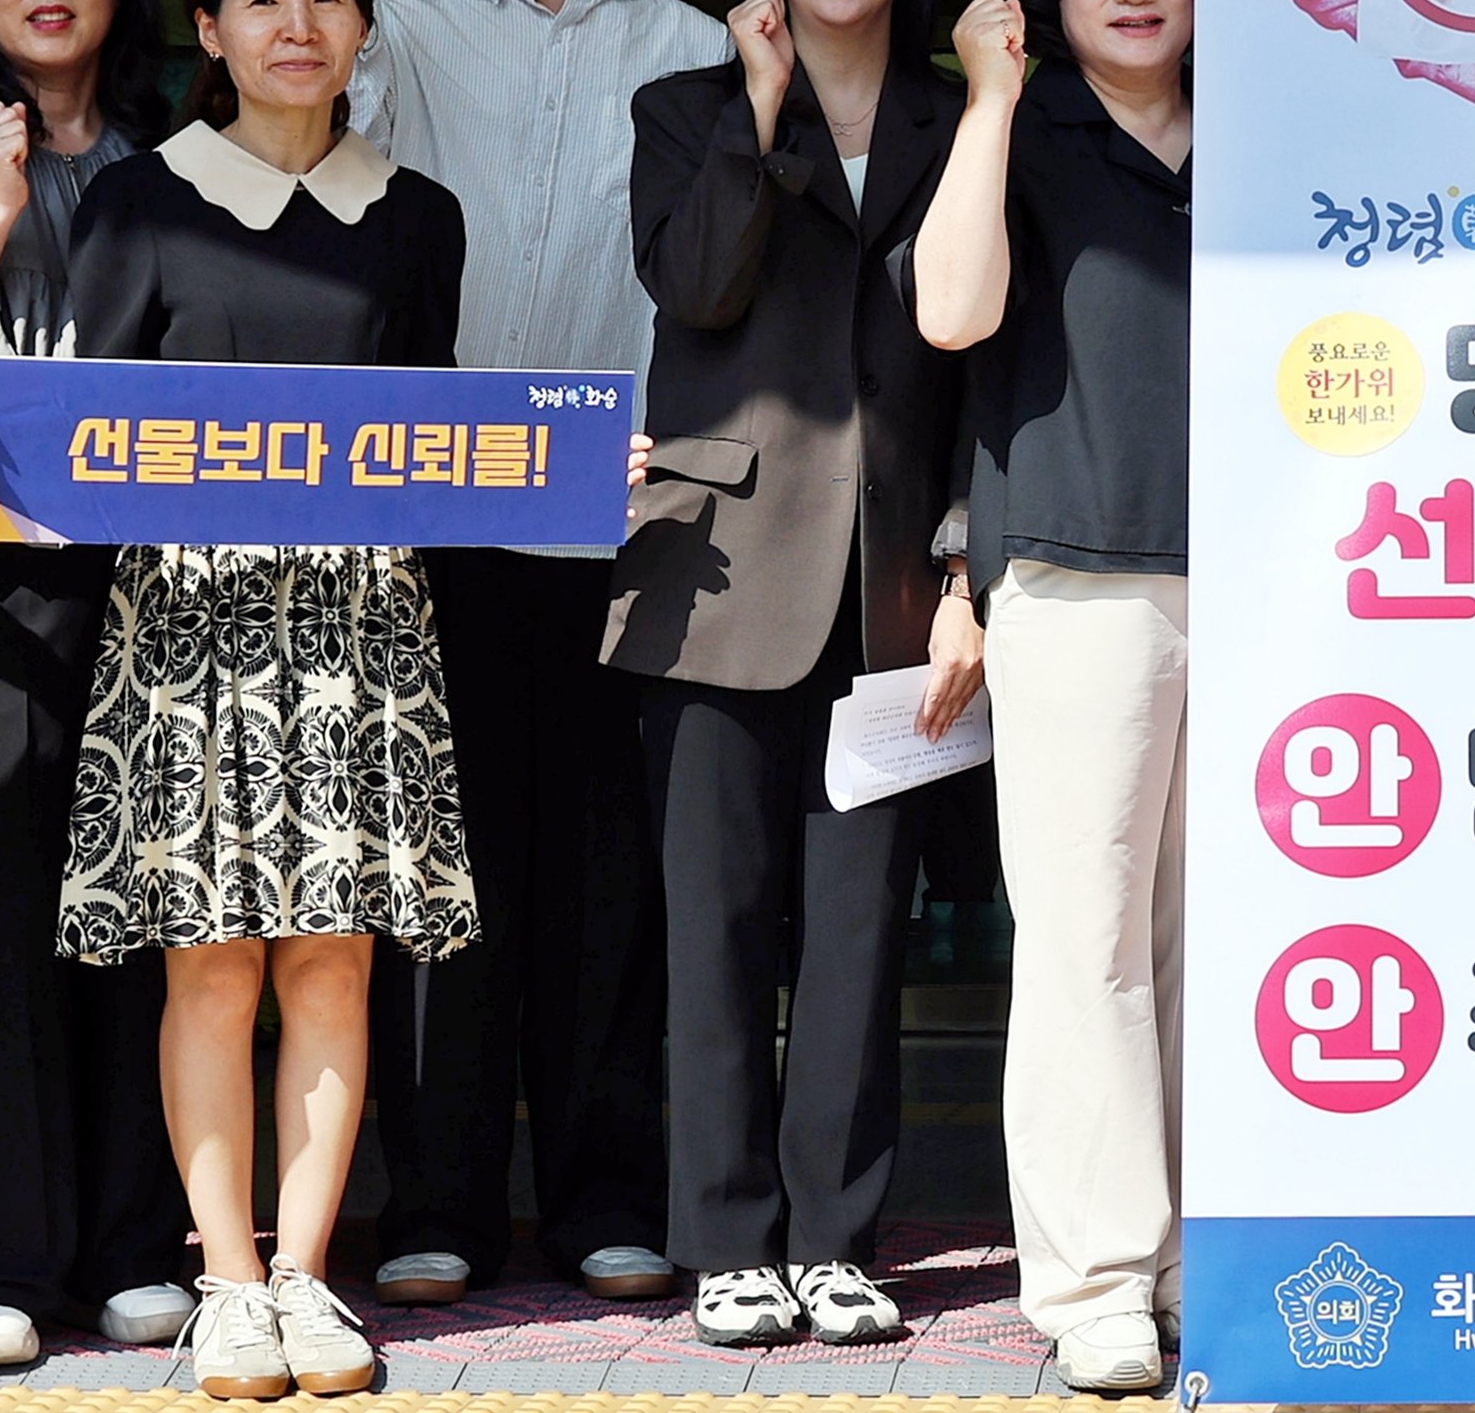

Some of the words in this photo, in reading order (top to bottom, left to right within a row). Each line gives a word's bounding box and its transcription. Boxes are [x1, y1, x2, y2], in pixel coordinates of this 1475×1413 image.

[1311, 191, 1445, 267] 청렴
[1308, 341, 1391, 363] 풍요로운
[1304, 367, 1393, 399] 한가위
[1305, 404, 1395, 425] 보내세요!
[67, 417, 329, 486] 선물보다
[347, 422, 549, 487] 신뢰를!
[1282, 723, 1415, 849] 안
[1282, 955, 1415, 1083] 안
[1315, 1300, 1361, 1325] 의회
